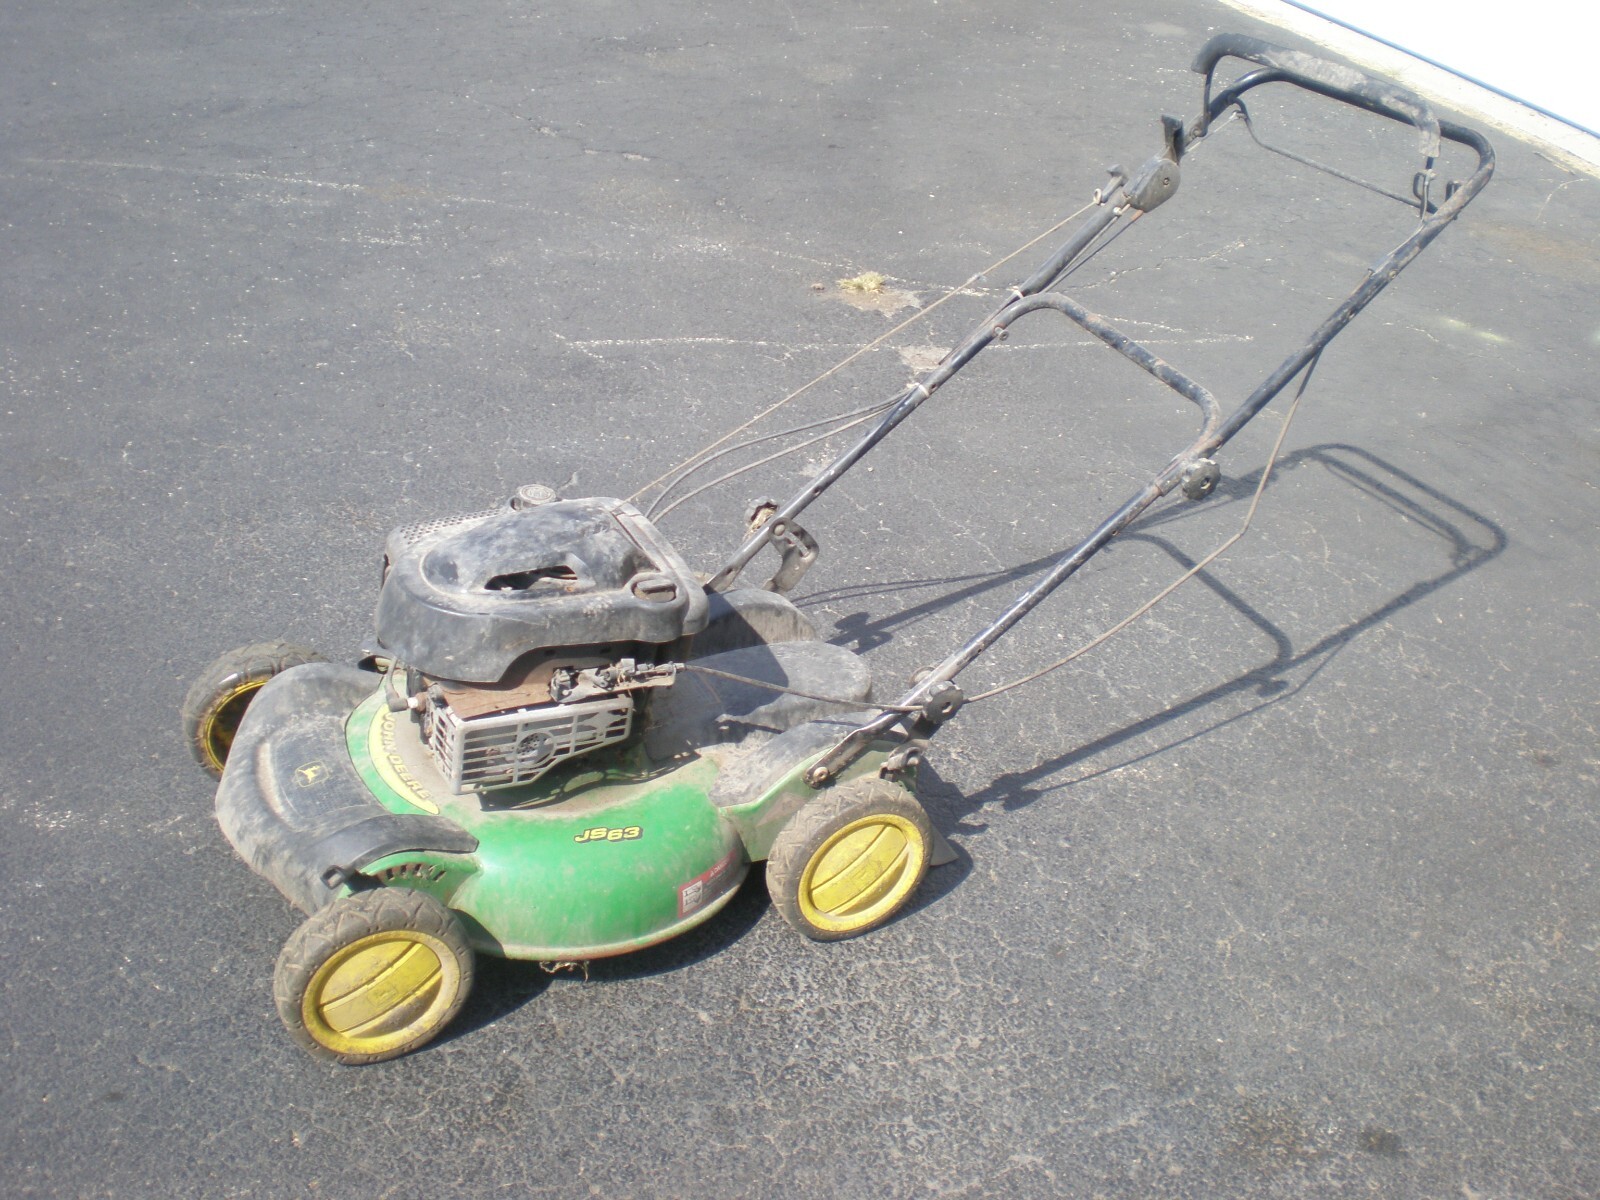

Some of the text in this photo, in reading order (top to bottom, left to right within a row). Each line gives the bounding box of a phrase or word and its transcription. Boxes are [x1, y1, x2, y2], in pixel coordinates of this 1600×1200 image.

[381, 711, 431, 800] JOHN DEERE
[574, 826, 643, 843] JS63
